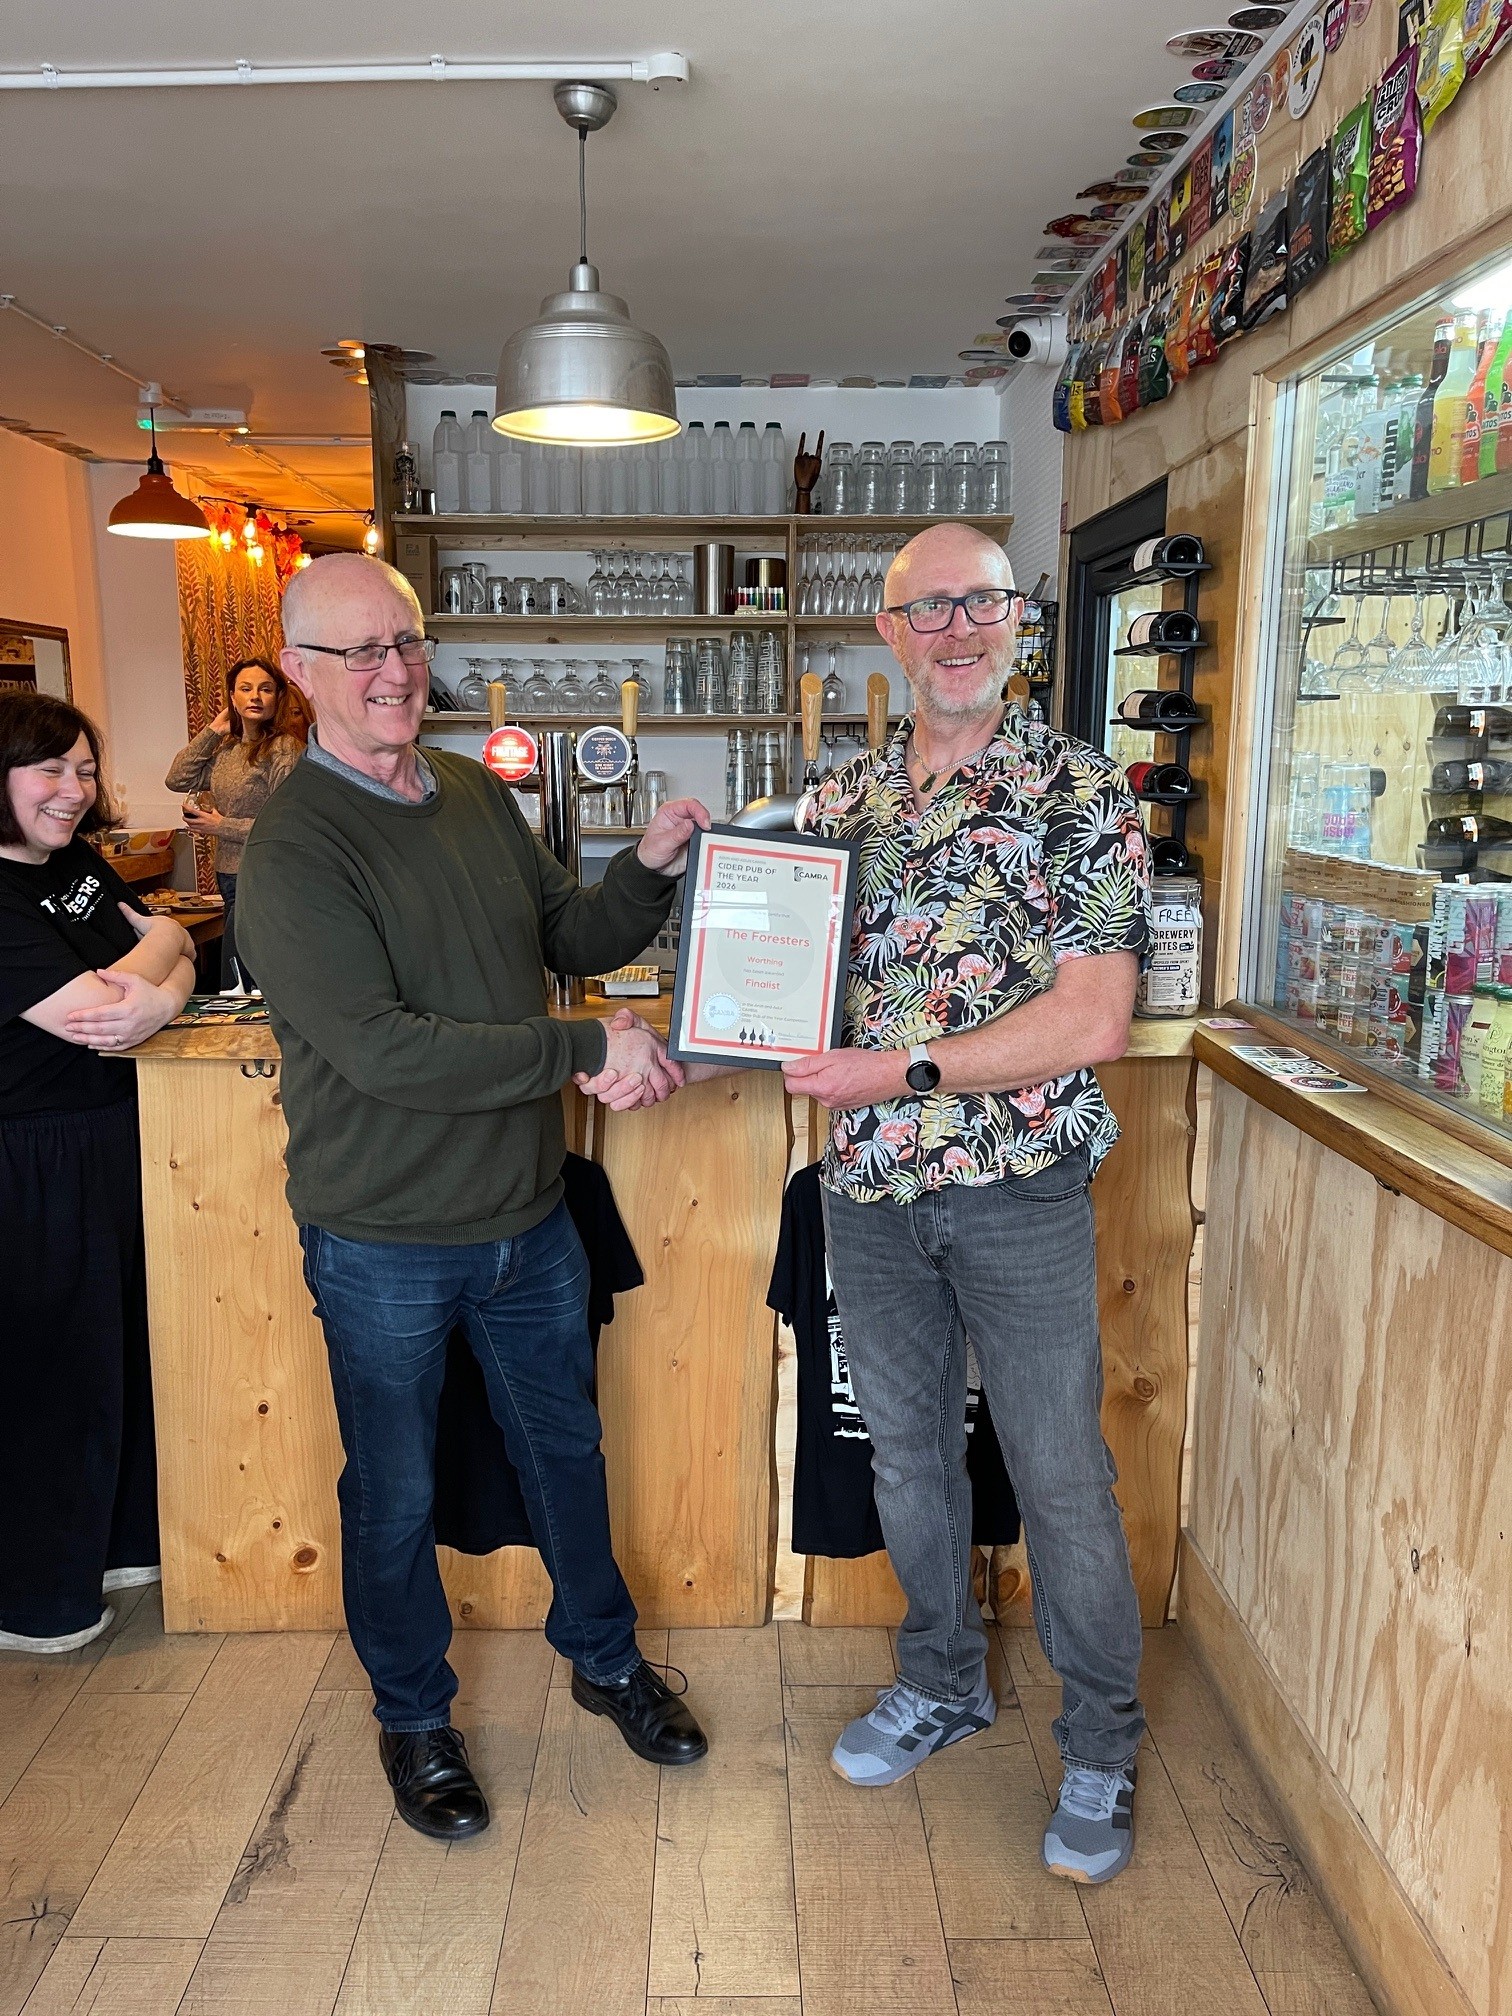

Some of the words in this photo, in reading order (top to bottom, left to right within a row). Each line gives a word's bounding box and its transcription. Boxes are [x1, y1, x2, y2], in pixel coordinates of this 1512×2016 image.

[718, 862, 743, 872] CIDER
[745, 865, 763, 874] PUB
[717, 872, 734, 880] THE
[736, 873, 759, 883] YEAR
[799, 871, 828, 881] CAMRA
[716, 881, 736, 890] 2026
[1158, 907, 1194, 923] FREE
[724, 928, 748, 940] The
[751, 931, 811, 948] Foresters
[1153, 929, 1195, 940] BREWERY
[1153, 941, 1178, 951] BITES
[747, 956, 784, 967] Worthing
[745, 978, 780, 990] Finalist
